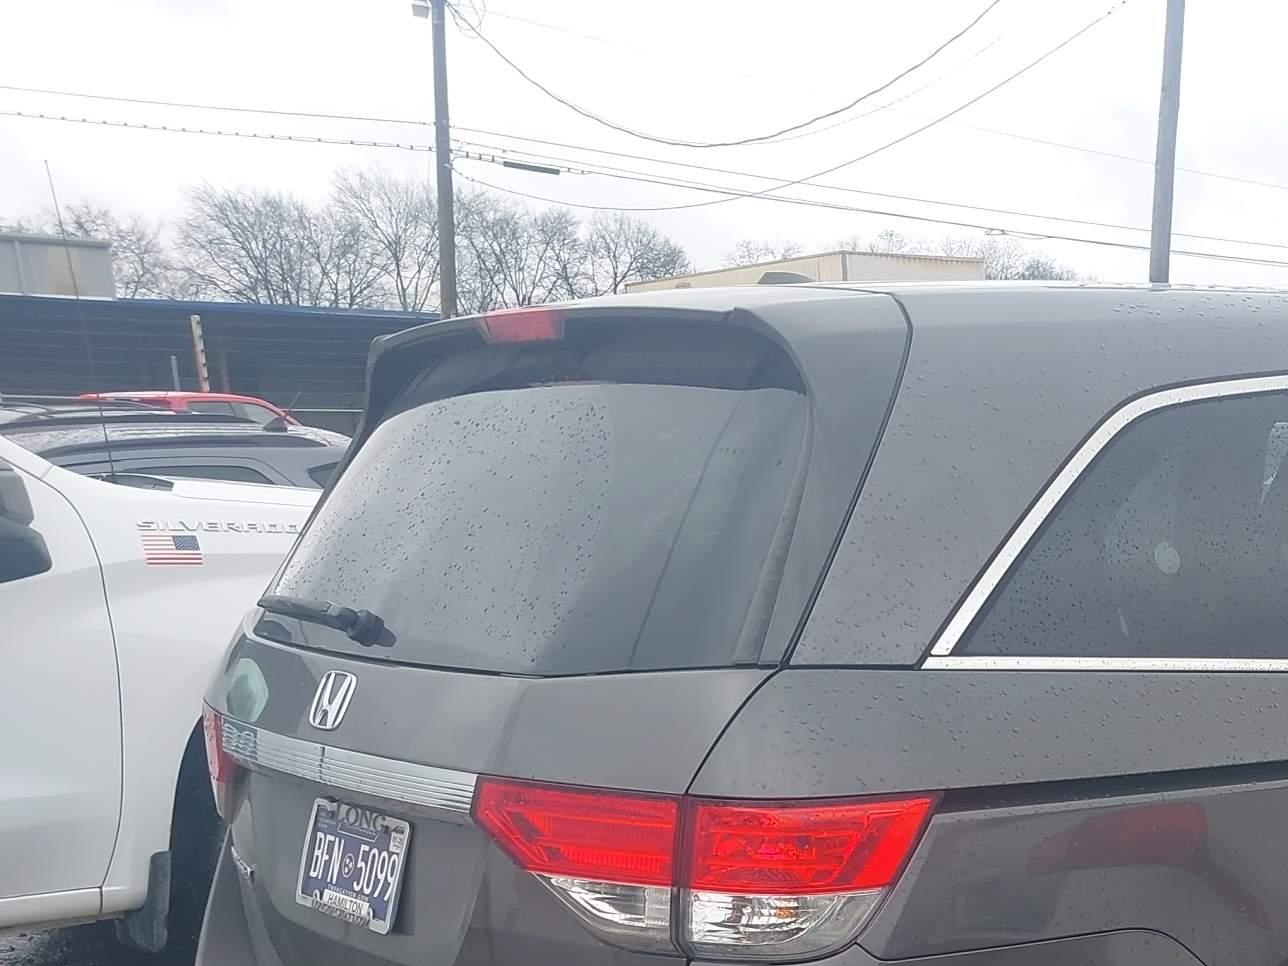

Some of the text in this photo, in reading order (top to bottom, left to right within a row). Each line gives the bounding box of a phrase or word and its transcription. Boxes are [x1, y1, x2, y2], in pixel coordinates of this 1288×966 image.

[136, 520, 302, 535] SILVERADO
[309, 831, 345, 885] BFN
[353, 844, 399, 901] 5099
[327, 892, 364, 916] HAMILTON
